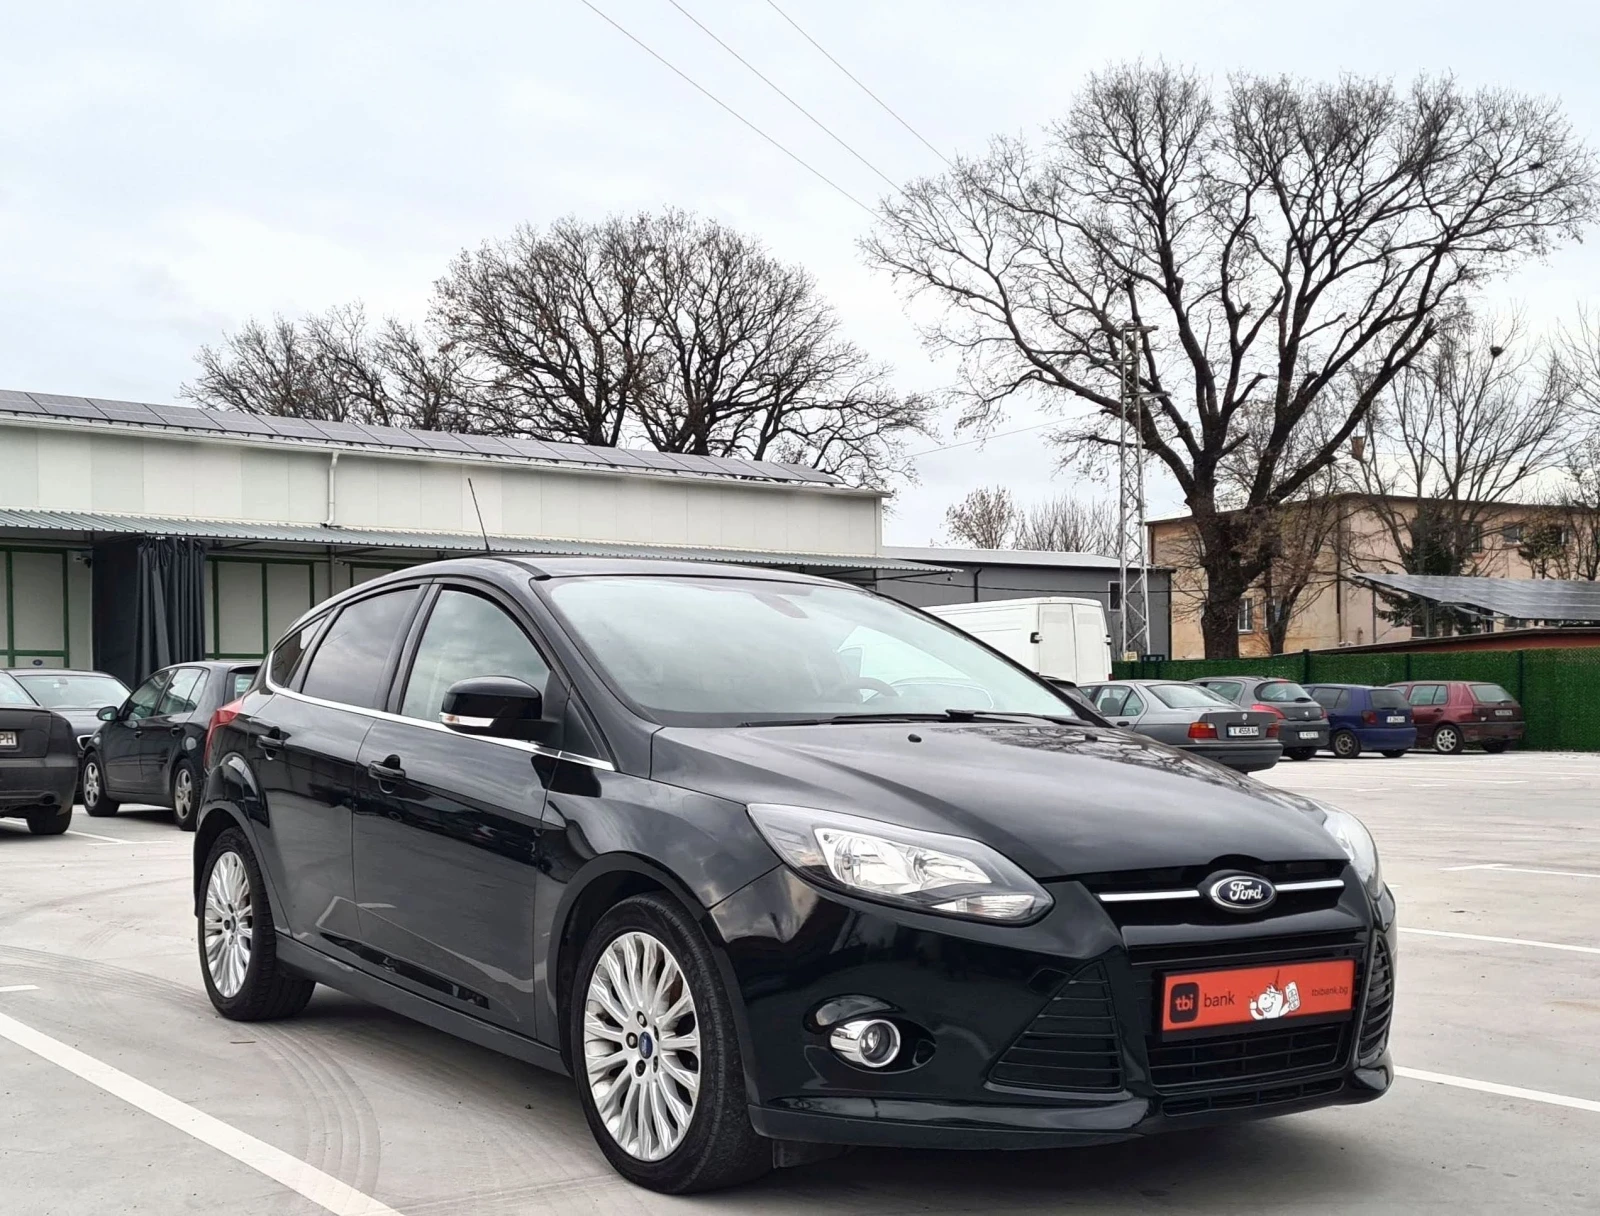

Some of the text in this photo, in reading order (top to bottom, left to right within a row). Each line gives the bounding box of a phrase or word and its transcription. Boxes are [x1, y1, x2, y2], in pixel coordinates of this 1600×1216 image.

[1229, 881, 1263, 900] Ford
[1311, 986, 1348, 996] tbibank.bg
[1176, 991, 1235, 1011] tbi bank
